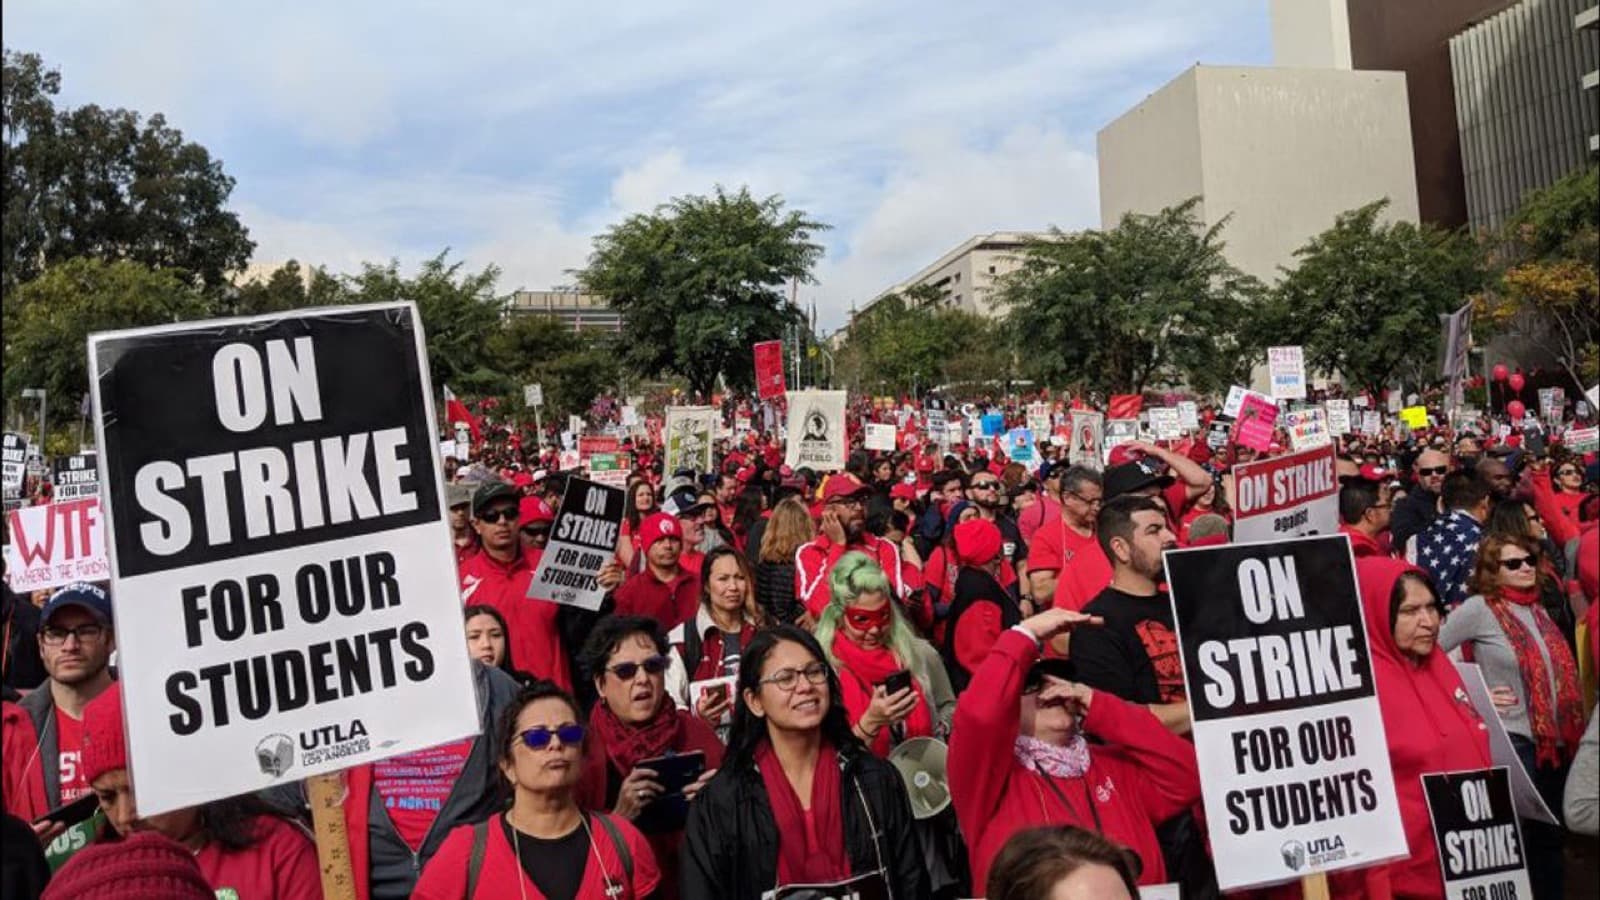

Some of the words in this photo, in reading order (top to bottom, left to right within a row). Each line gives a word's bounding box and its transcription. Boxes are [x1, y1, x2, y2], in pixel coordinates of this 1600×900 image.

[212, 335, 323, 432] ON
[58, 469, 97, 485] STRIKE
[69, 456, 86, 469] ON
[1239, 472, 1268, 512] ON
[1273, 455, 1334, 505] STRIKE
[59, 485, 78, 498] FOR
[133, 426, 419, 557] STRIKE
[584, 485, 608, 516] ON
[9, 498, 98, 567] WTF
[557, 512, 619, 548] STRIKE
[1274, 508, 1308, 532] against
[540, 567, 599, 592] STUDENTS
[554, 547, 580, 566] FOR
[578, 552, 604, 571] OUR
[180, 573, 285, 648] FOR
[294, 551, 402, 624] OUR
[1237, 555, 1305, 626] ON
[164, 621, 435, 736] STUDENTS
[1197, 625, 1363, 709] STRIKE
[300, 719, 369, 750] UTLA
[303, 754, 322, 767] LOS
[325, 744, 371, 761] ANGELES
[1231, 725, 1294, 775] FOR
[1297, 716, 1357, 763] OUR
[1225, 768, 1378, 835] STUDENTS
[1460, 779, 1494, 822] ON
[1307, 835, 1345, 855] UTLA
[1444, 823, 1520, 875] STRIKE
